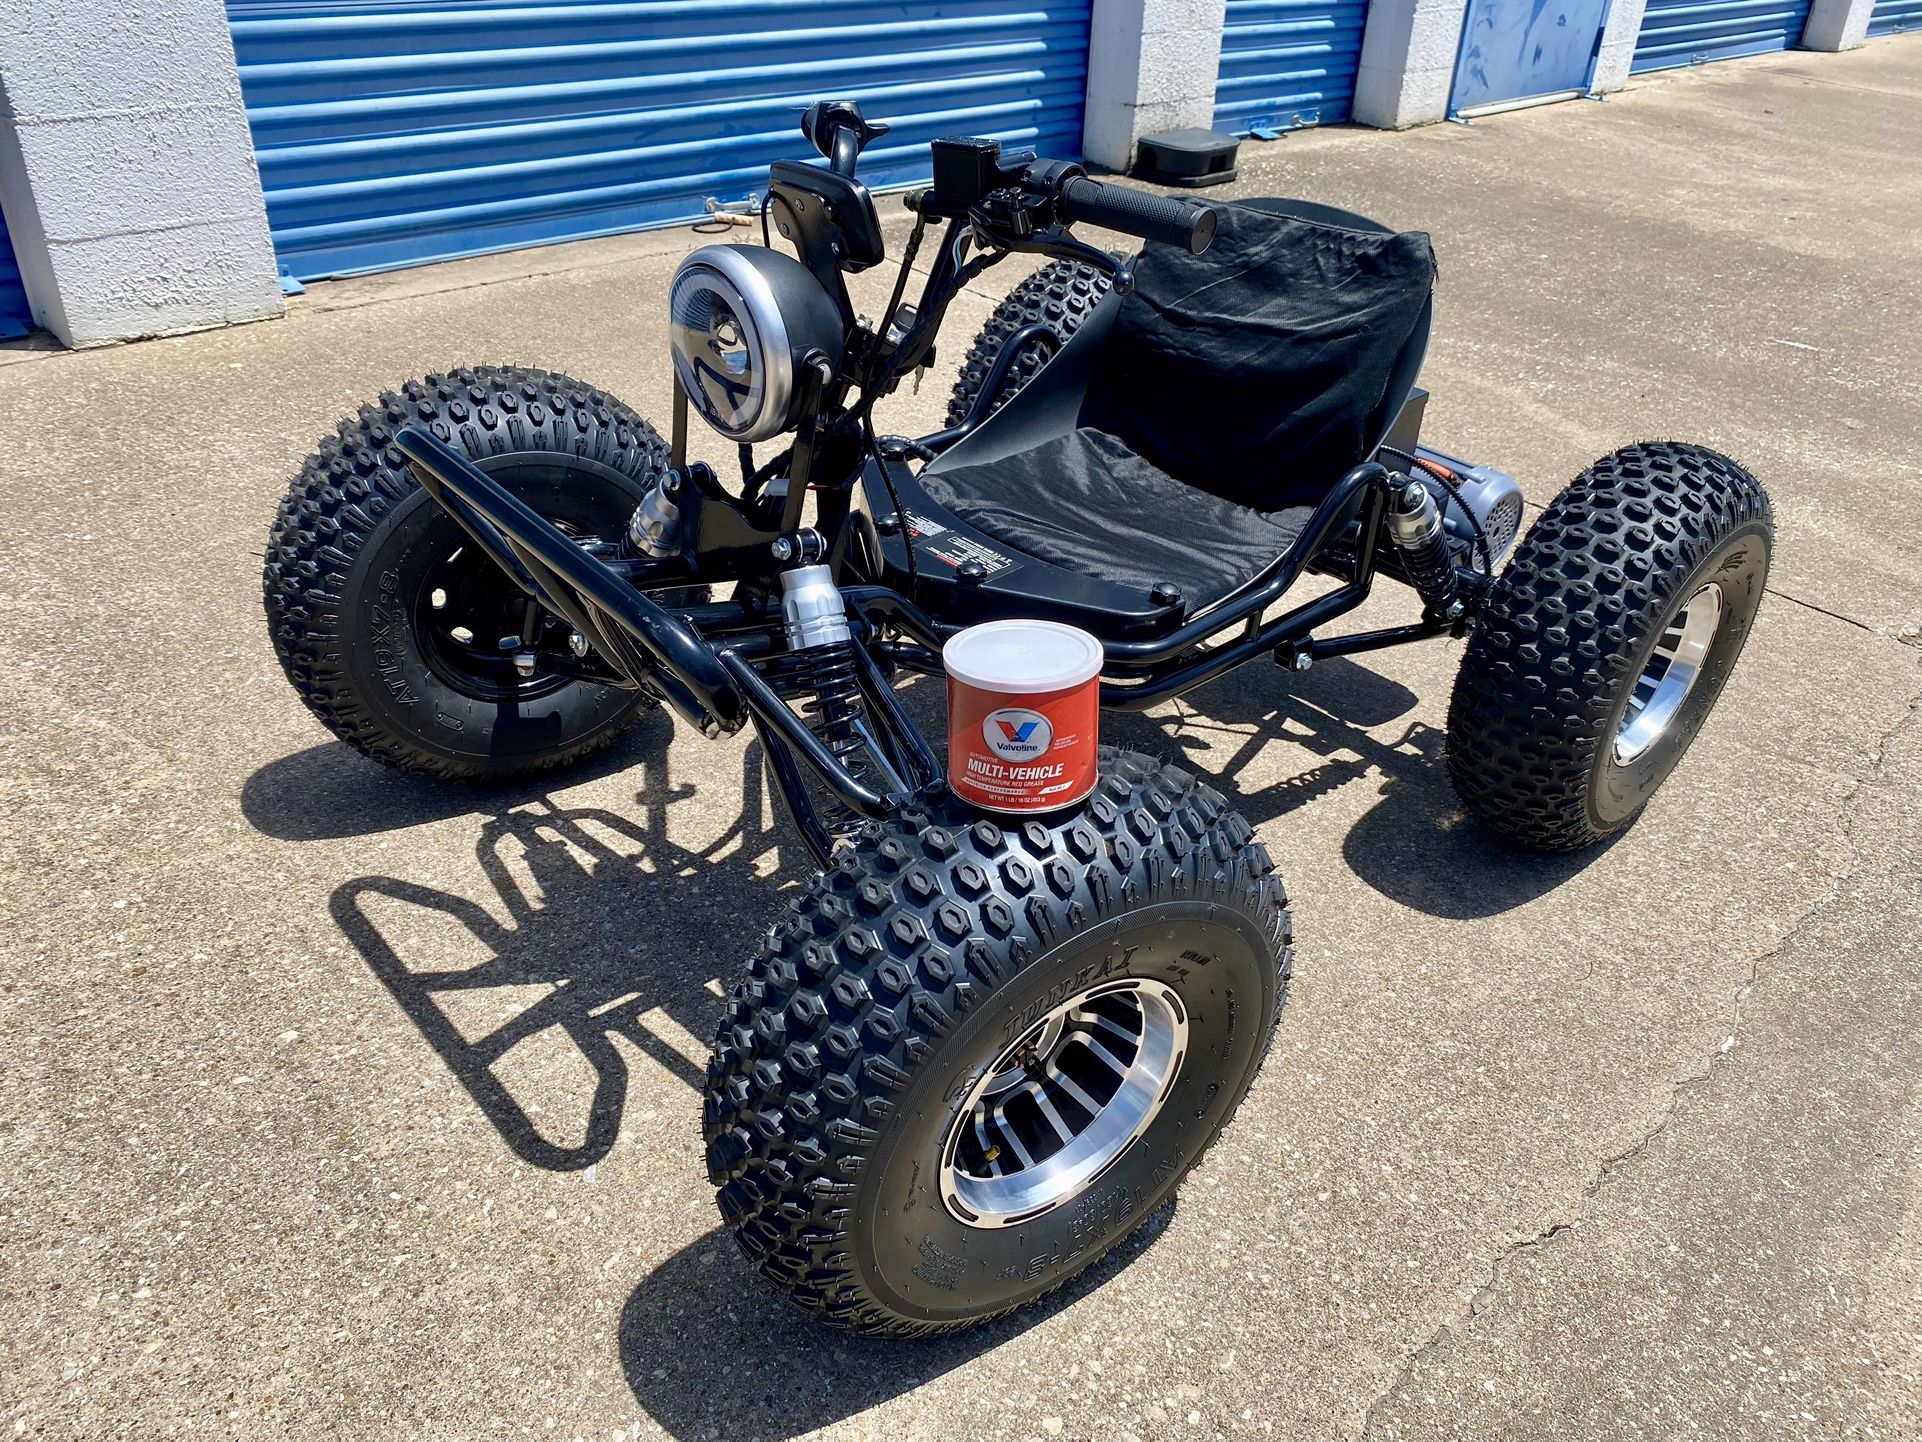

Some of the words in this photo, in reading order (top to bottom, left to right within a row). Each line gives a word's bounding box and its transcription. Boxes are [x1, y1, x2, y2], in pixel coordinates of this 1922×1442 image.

[996, 742, 1039, 752] Valvoline
[969, 751, 998, 764] AUTOMOTIVE
[967, 758, 1065, 780] MULTI-VEHICLE
[976, 773, 1011, 786] TEMPERATURE
[988, 793, 997, 801] NET
[999, 945, 1140, 1050] JUNKAI
